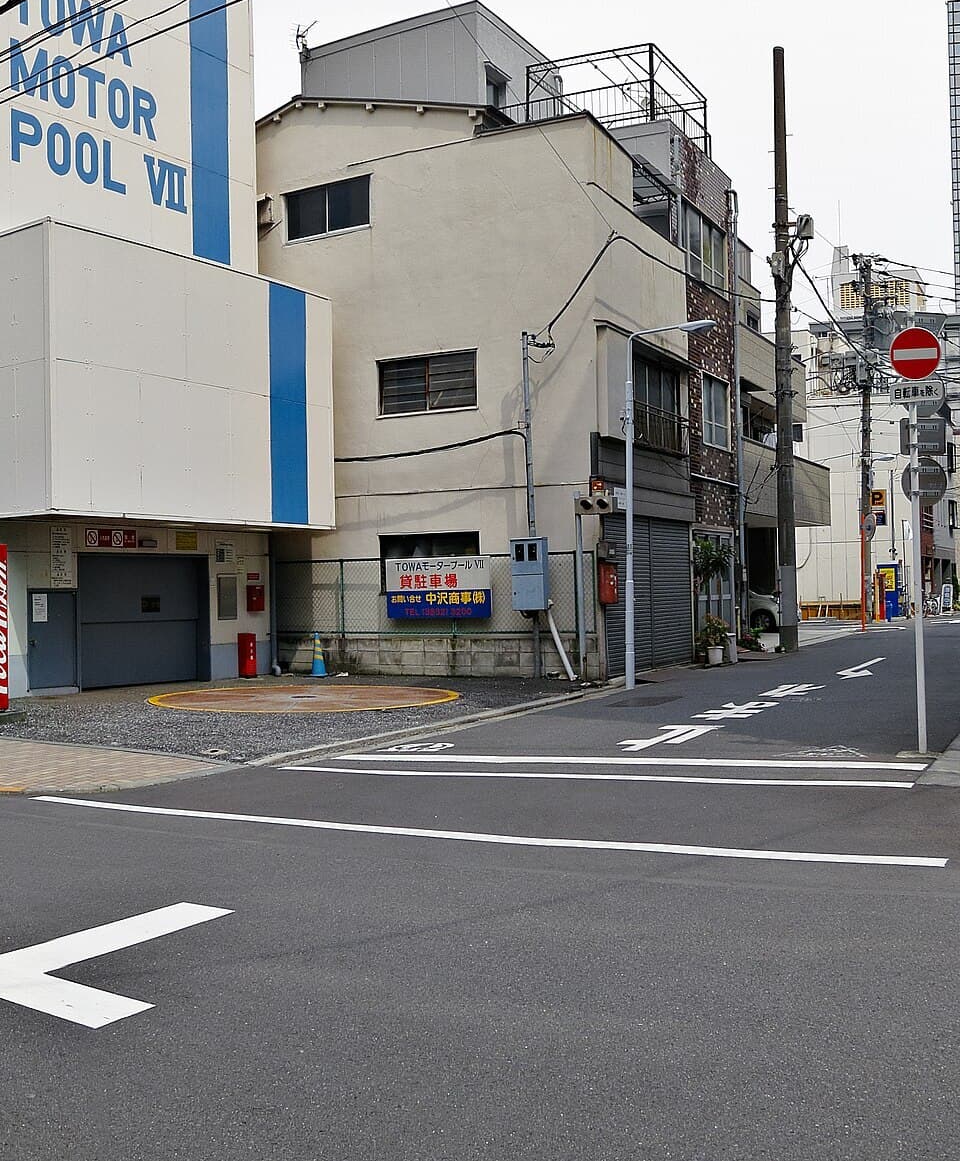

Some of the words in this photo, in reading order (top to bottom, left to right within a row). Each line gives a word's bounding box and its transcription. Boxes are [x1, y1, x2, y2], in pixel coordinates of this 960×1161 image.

[9, 37, 158, 142] MOTOR
[10, 107, 127, 196] POOL
[143, 154, 188, 215] VII
[894, 385, 939, 399] 自転車を除く
[400, 573, 458, 589] 貸駐車場
